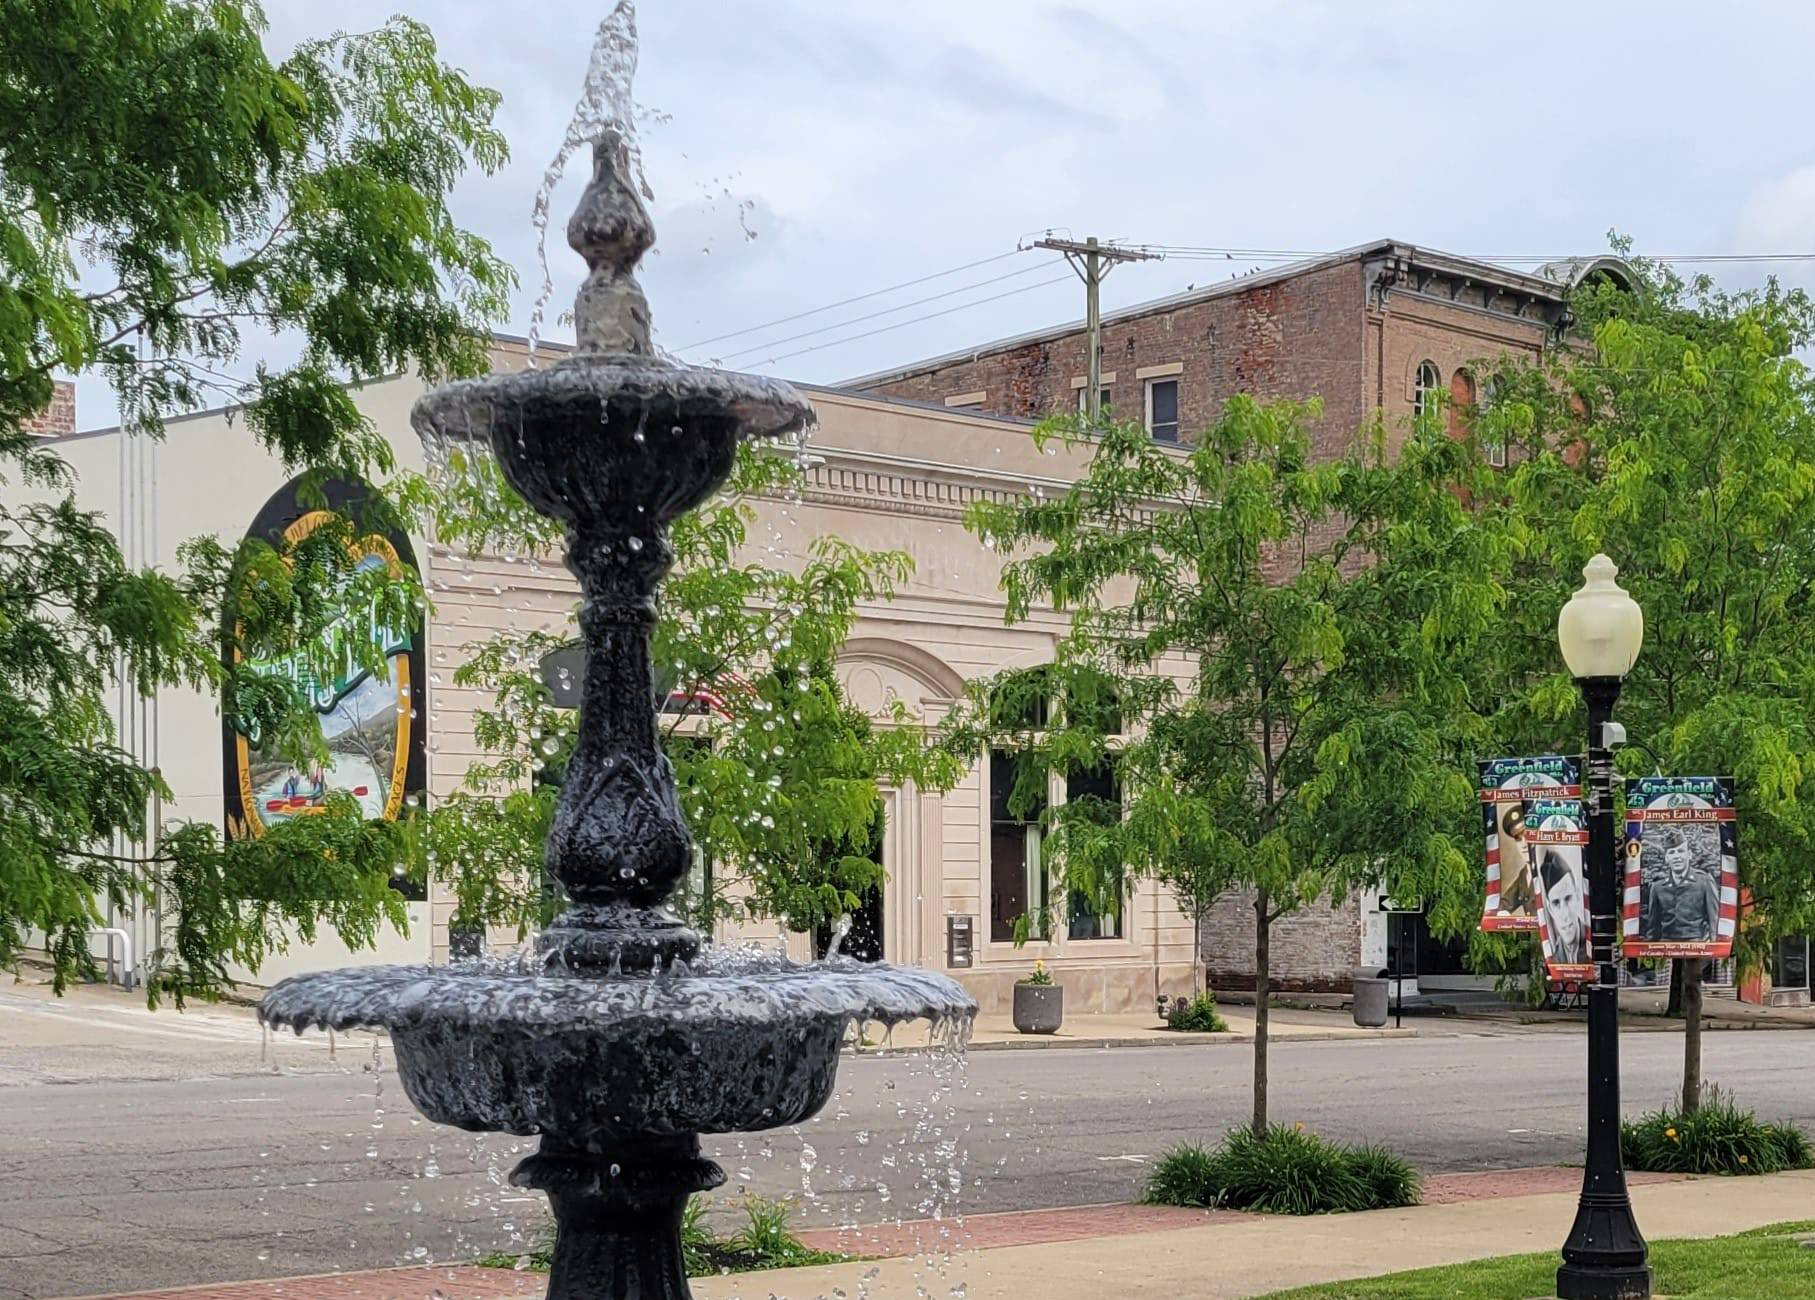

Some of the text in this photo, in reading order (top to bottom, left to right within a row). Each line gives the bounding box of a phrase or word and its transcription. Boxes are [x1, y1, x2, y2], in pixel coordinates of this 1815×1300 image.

[1494, 760, 1563, 774] Greenfield
[1493, 789, 1519, 800] James
[1522, 786, 1570, 800] Fitzpatrick
[1641, 782, 1714, 793] Greenfield
[1535, 803, 1580, 815] Greenfield
[1642, 809, 1718, 821] James Earl King
